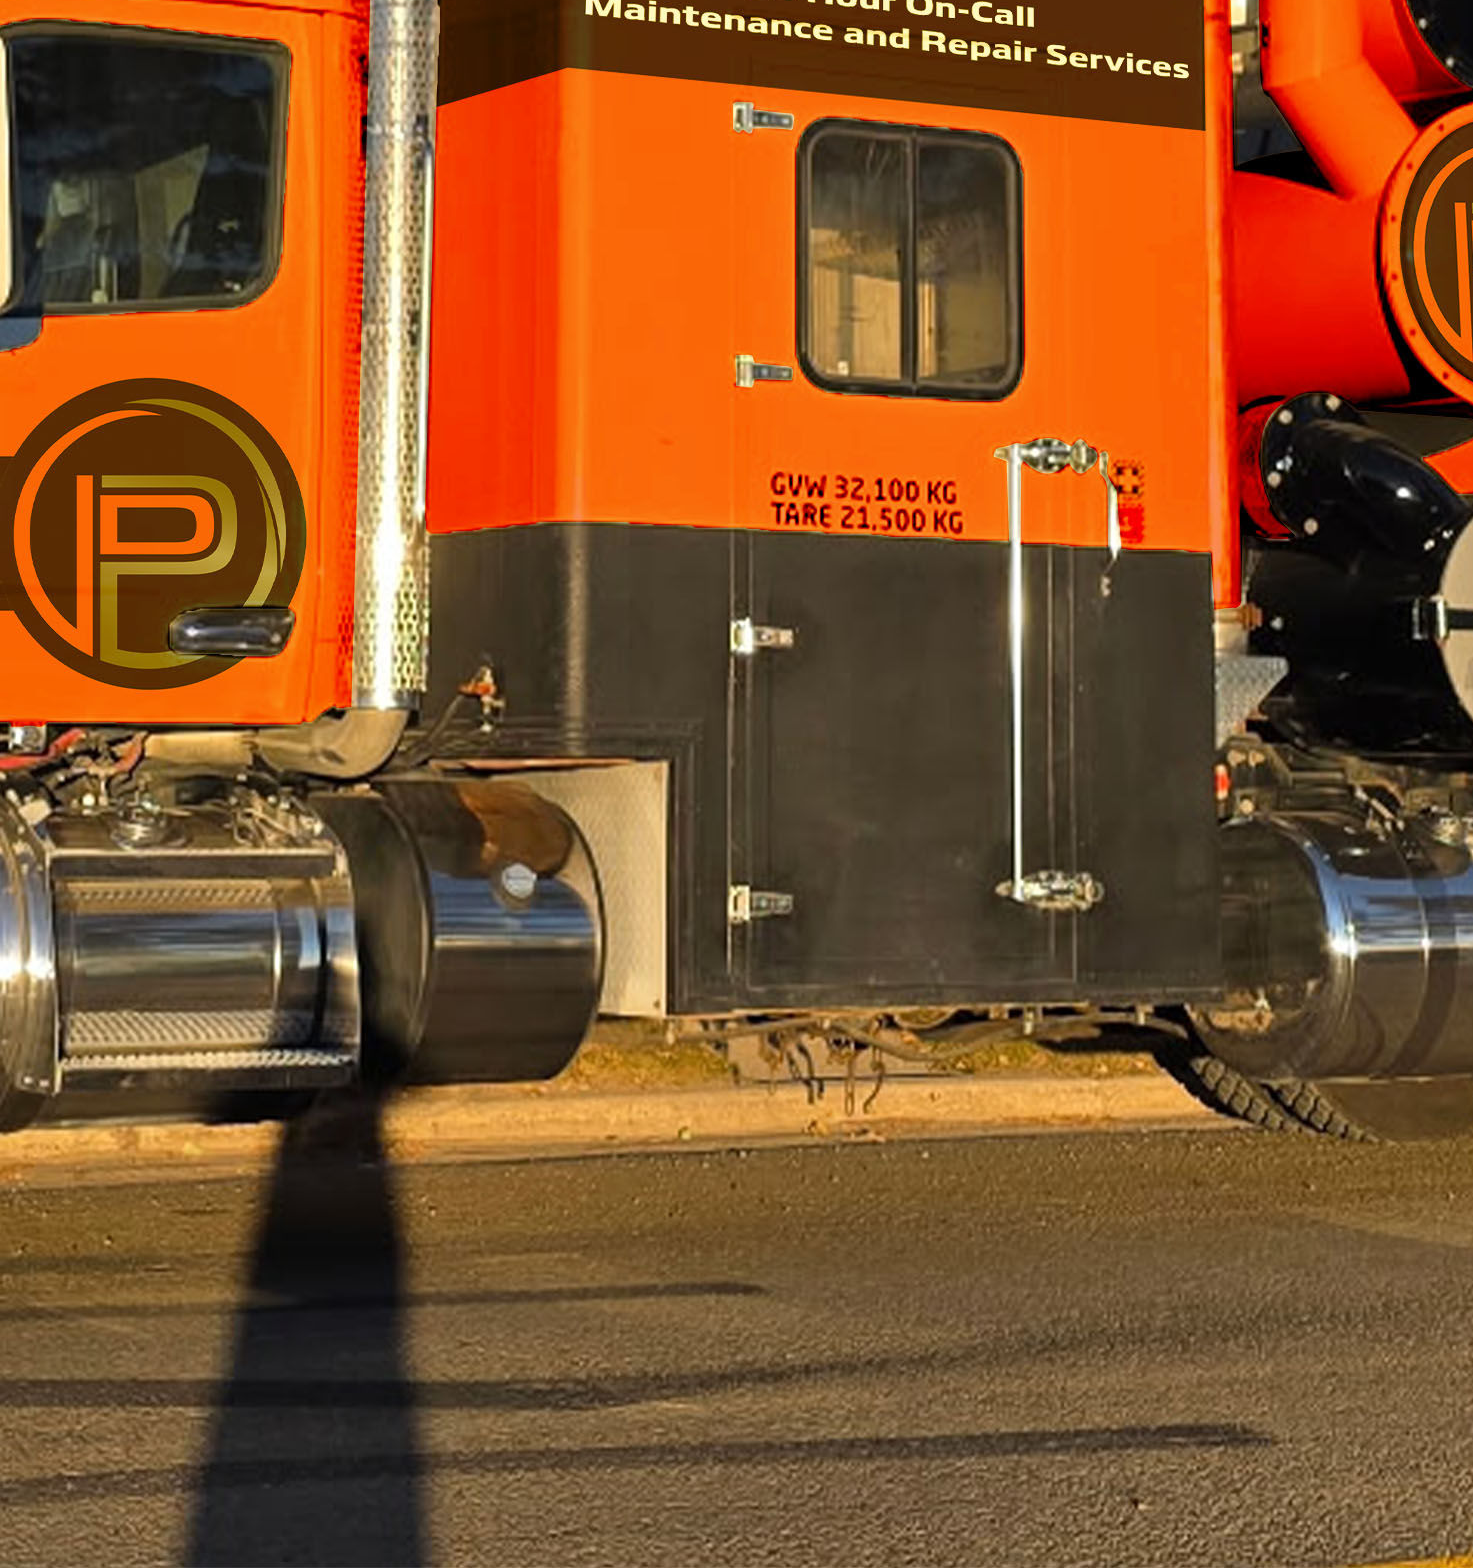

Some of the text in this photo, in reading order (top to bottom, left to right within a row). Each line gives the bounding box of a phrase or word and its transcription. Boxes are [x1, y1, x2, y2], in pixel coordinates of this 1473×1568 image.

[843, 27, 910, 50] and
[921, 29, 1038, 62] Repair
[1046, 43, 1190, 79] Services
[770, 471, 957, 505] GVW 32,100 KG
[770, 501, 831, 528] TARE
[933, 509, 963, 534] KG
